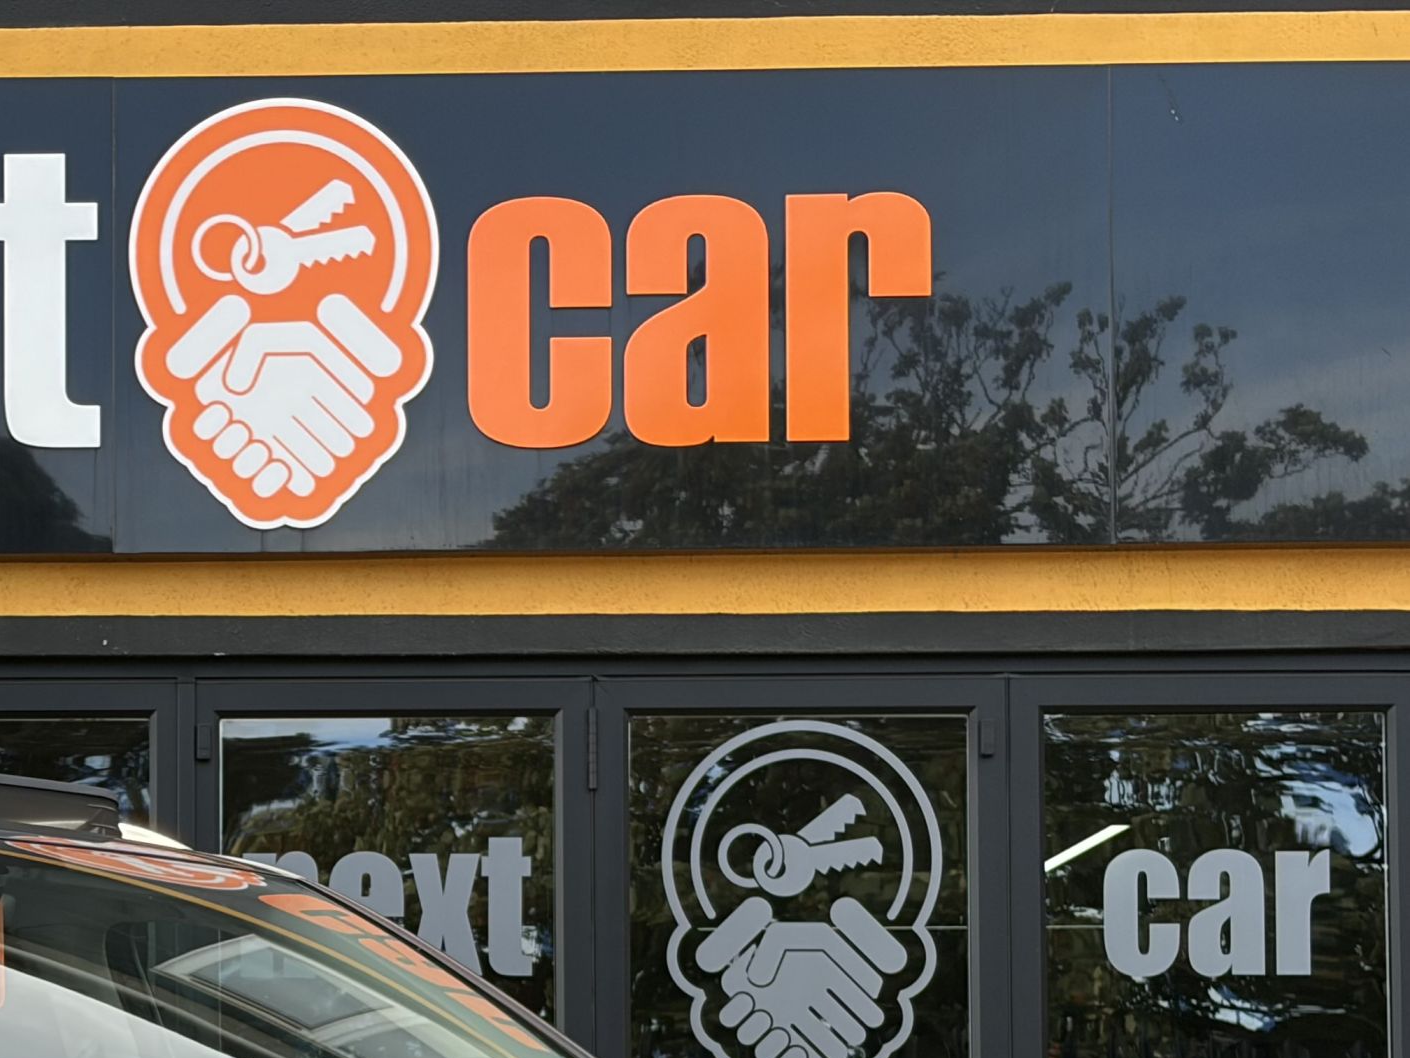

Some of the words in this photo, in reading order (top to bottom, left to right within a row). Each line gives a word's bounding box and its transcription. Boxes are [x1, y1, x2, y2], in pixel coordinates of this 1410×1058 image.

[468, 192, 933, 449] car
[242, 837, 532, 976] ext
[1103, 848, 1331, 978] car
